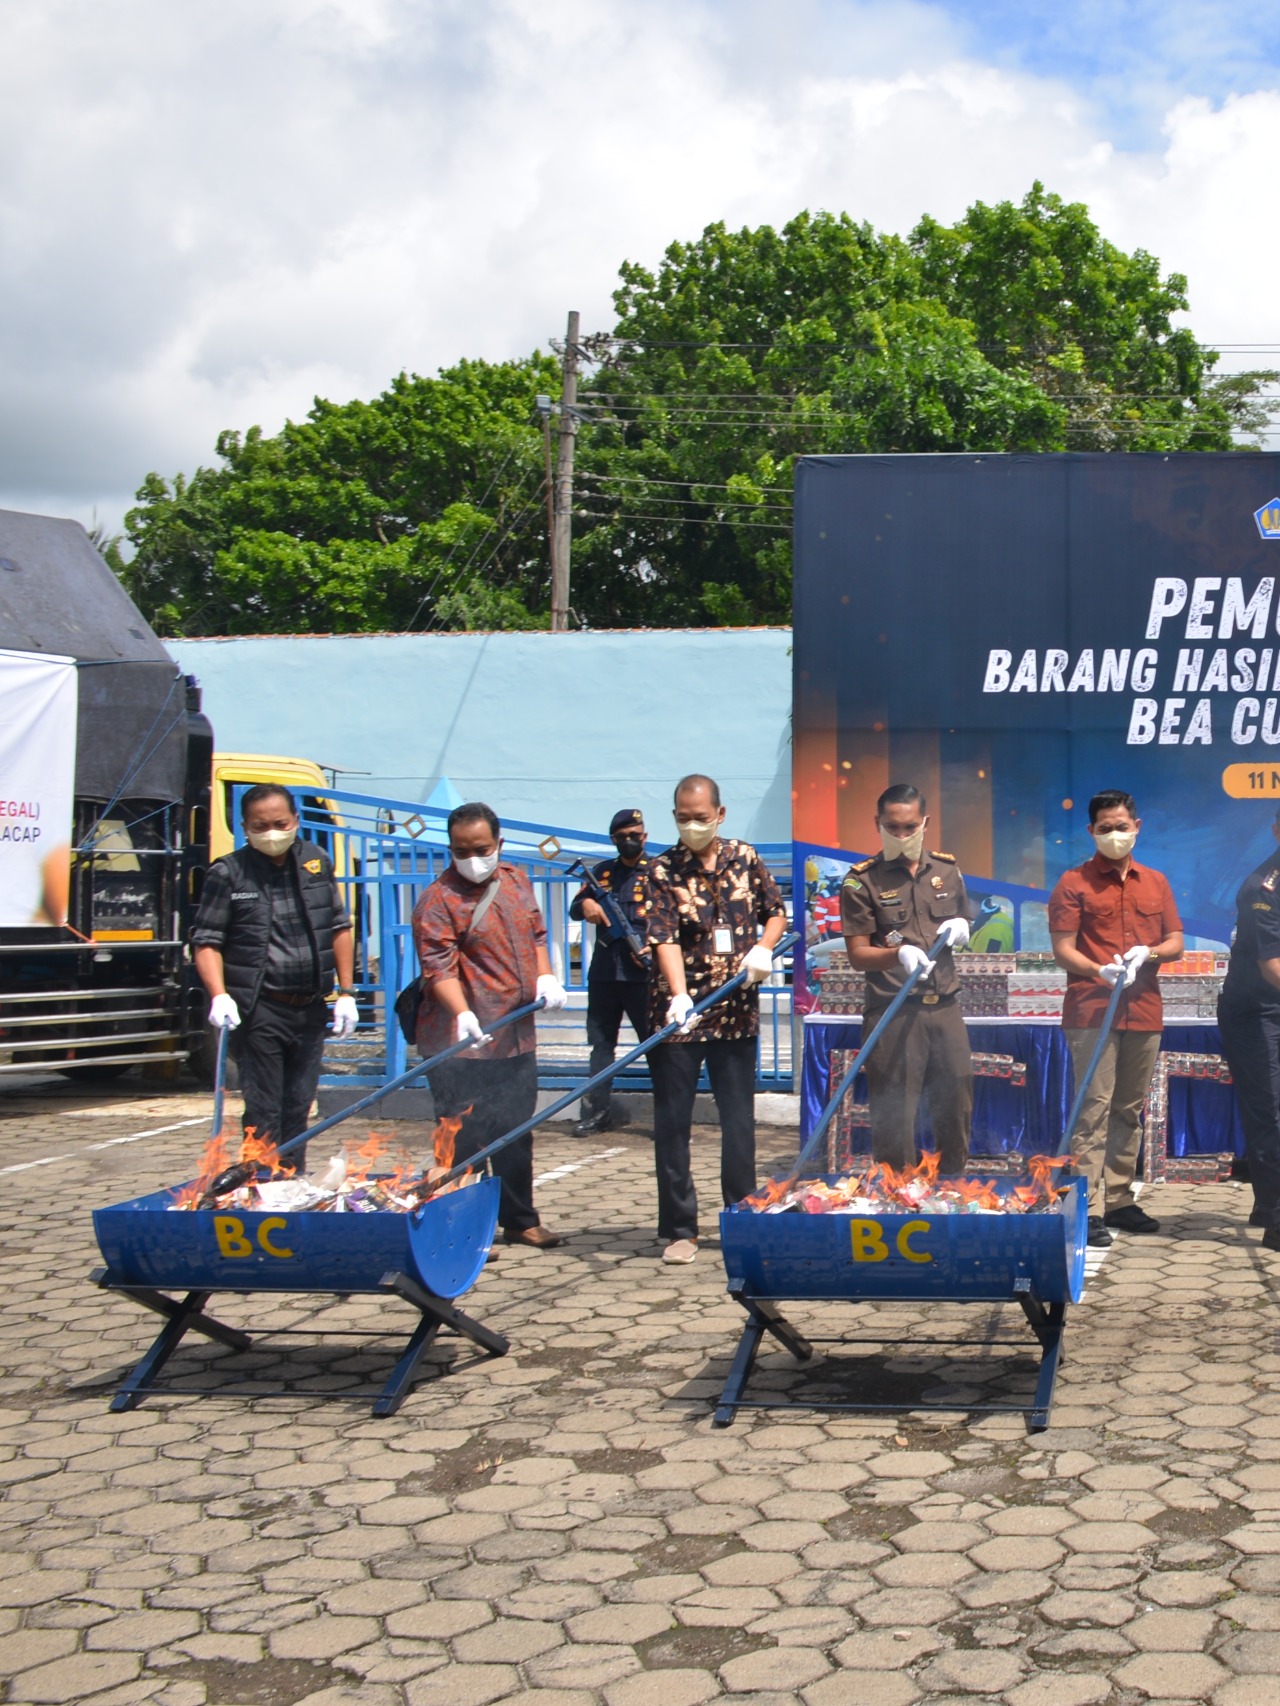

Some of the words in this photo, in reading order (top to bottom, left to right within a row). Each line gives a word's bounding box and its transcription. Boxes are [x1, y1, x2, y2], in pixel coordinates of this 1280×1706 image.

[982, 648, 1159, 693] BARANG
[1126, 697, 1213, 745] BEA
[1248, 772, 1264, 789] 11
[213, 1216, 295, 1259] BC
[850, 1219, 932, 1264] BC
